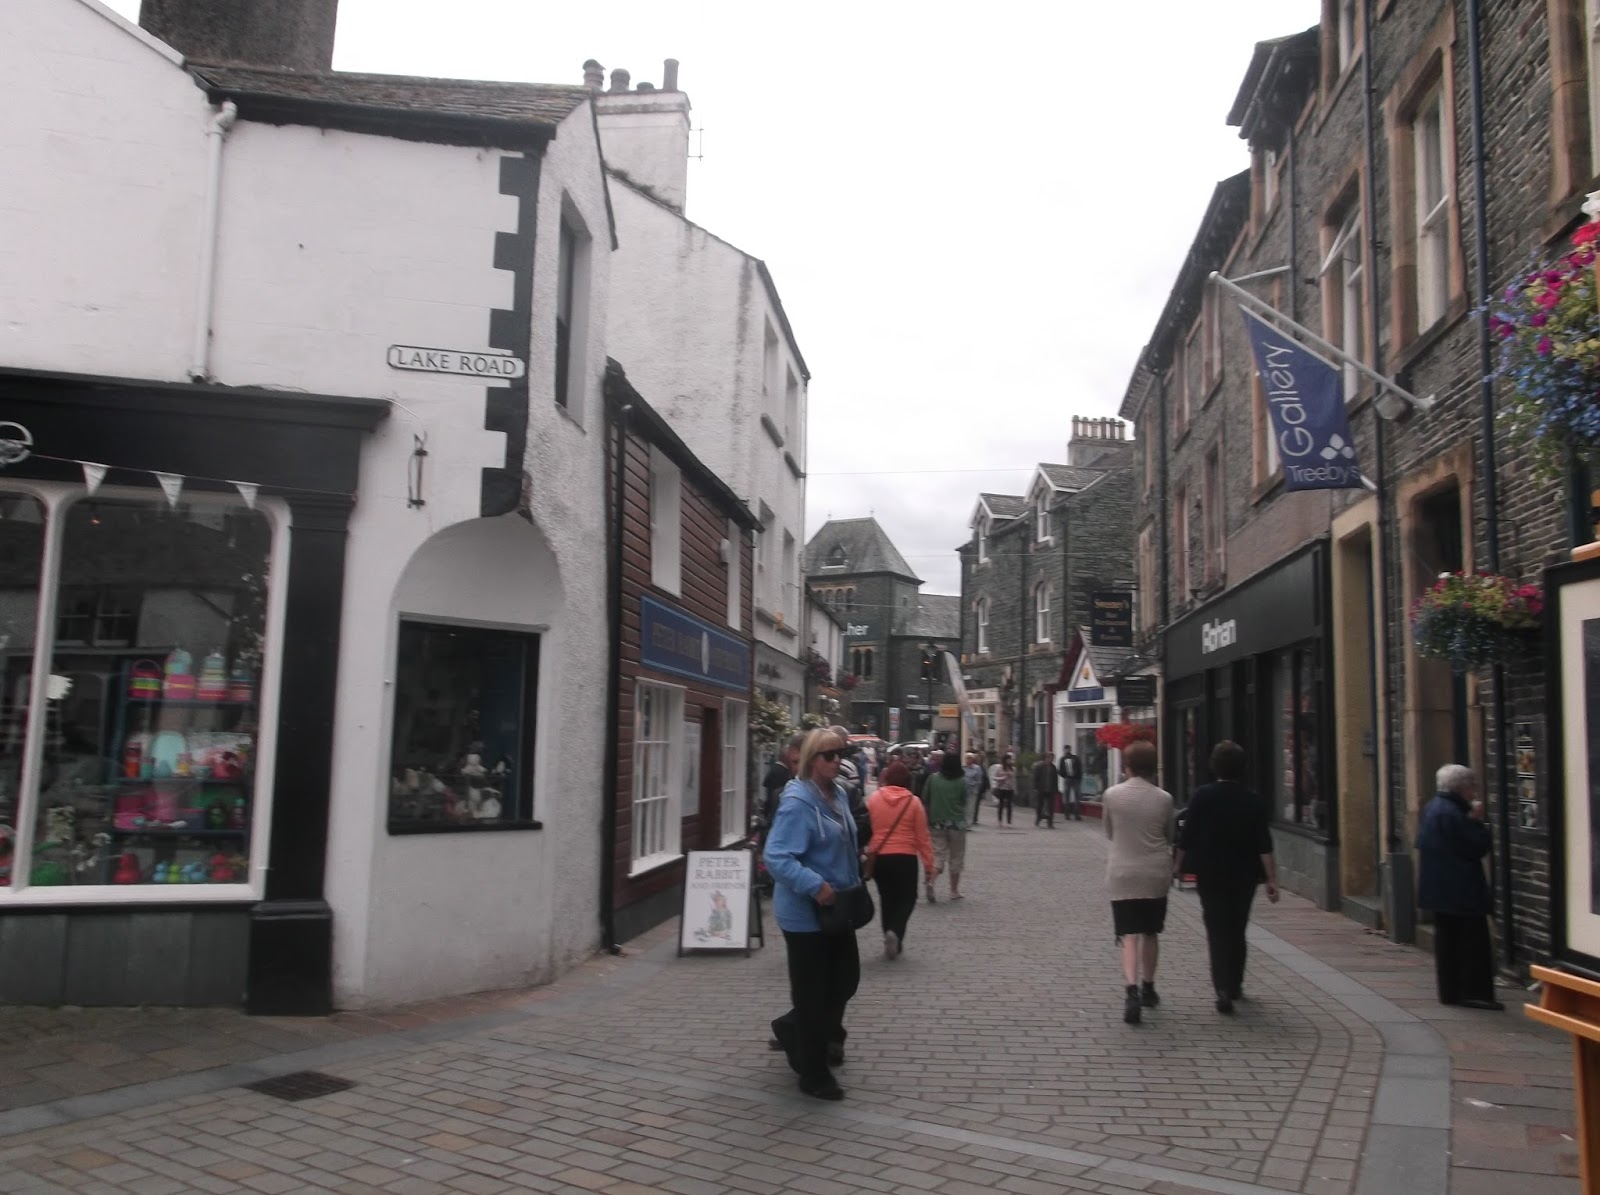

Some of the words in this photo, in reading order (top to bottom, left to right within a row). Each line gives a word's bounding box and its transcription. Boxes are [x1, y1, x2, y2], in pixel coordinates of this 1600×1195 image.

[398, 352, 449, 369] LAKE
[459, 356, 516, 375] ROAD
[1262, 342, 1314, 457] Gallery
[841, 621, 869, 636] her
[698, 857, 741, 868] PETER
[695, 869, 745, 880] RABBIT
